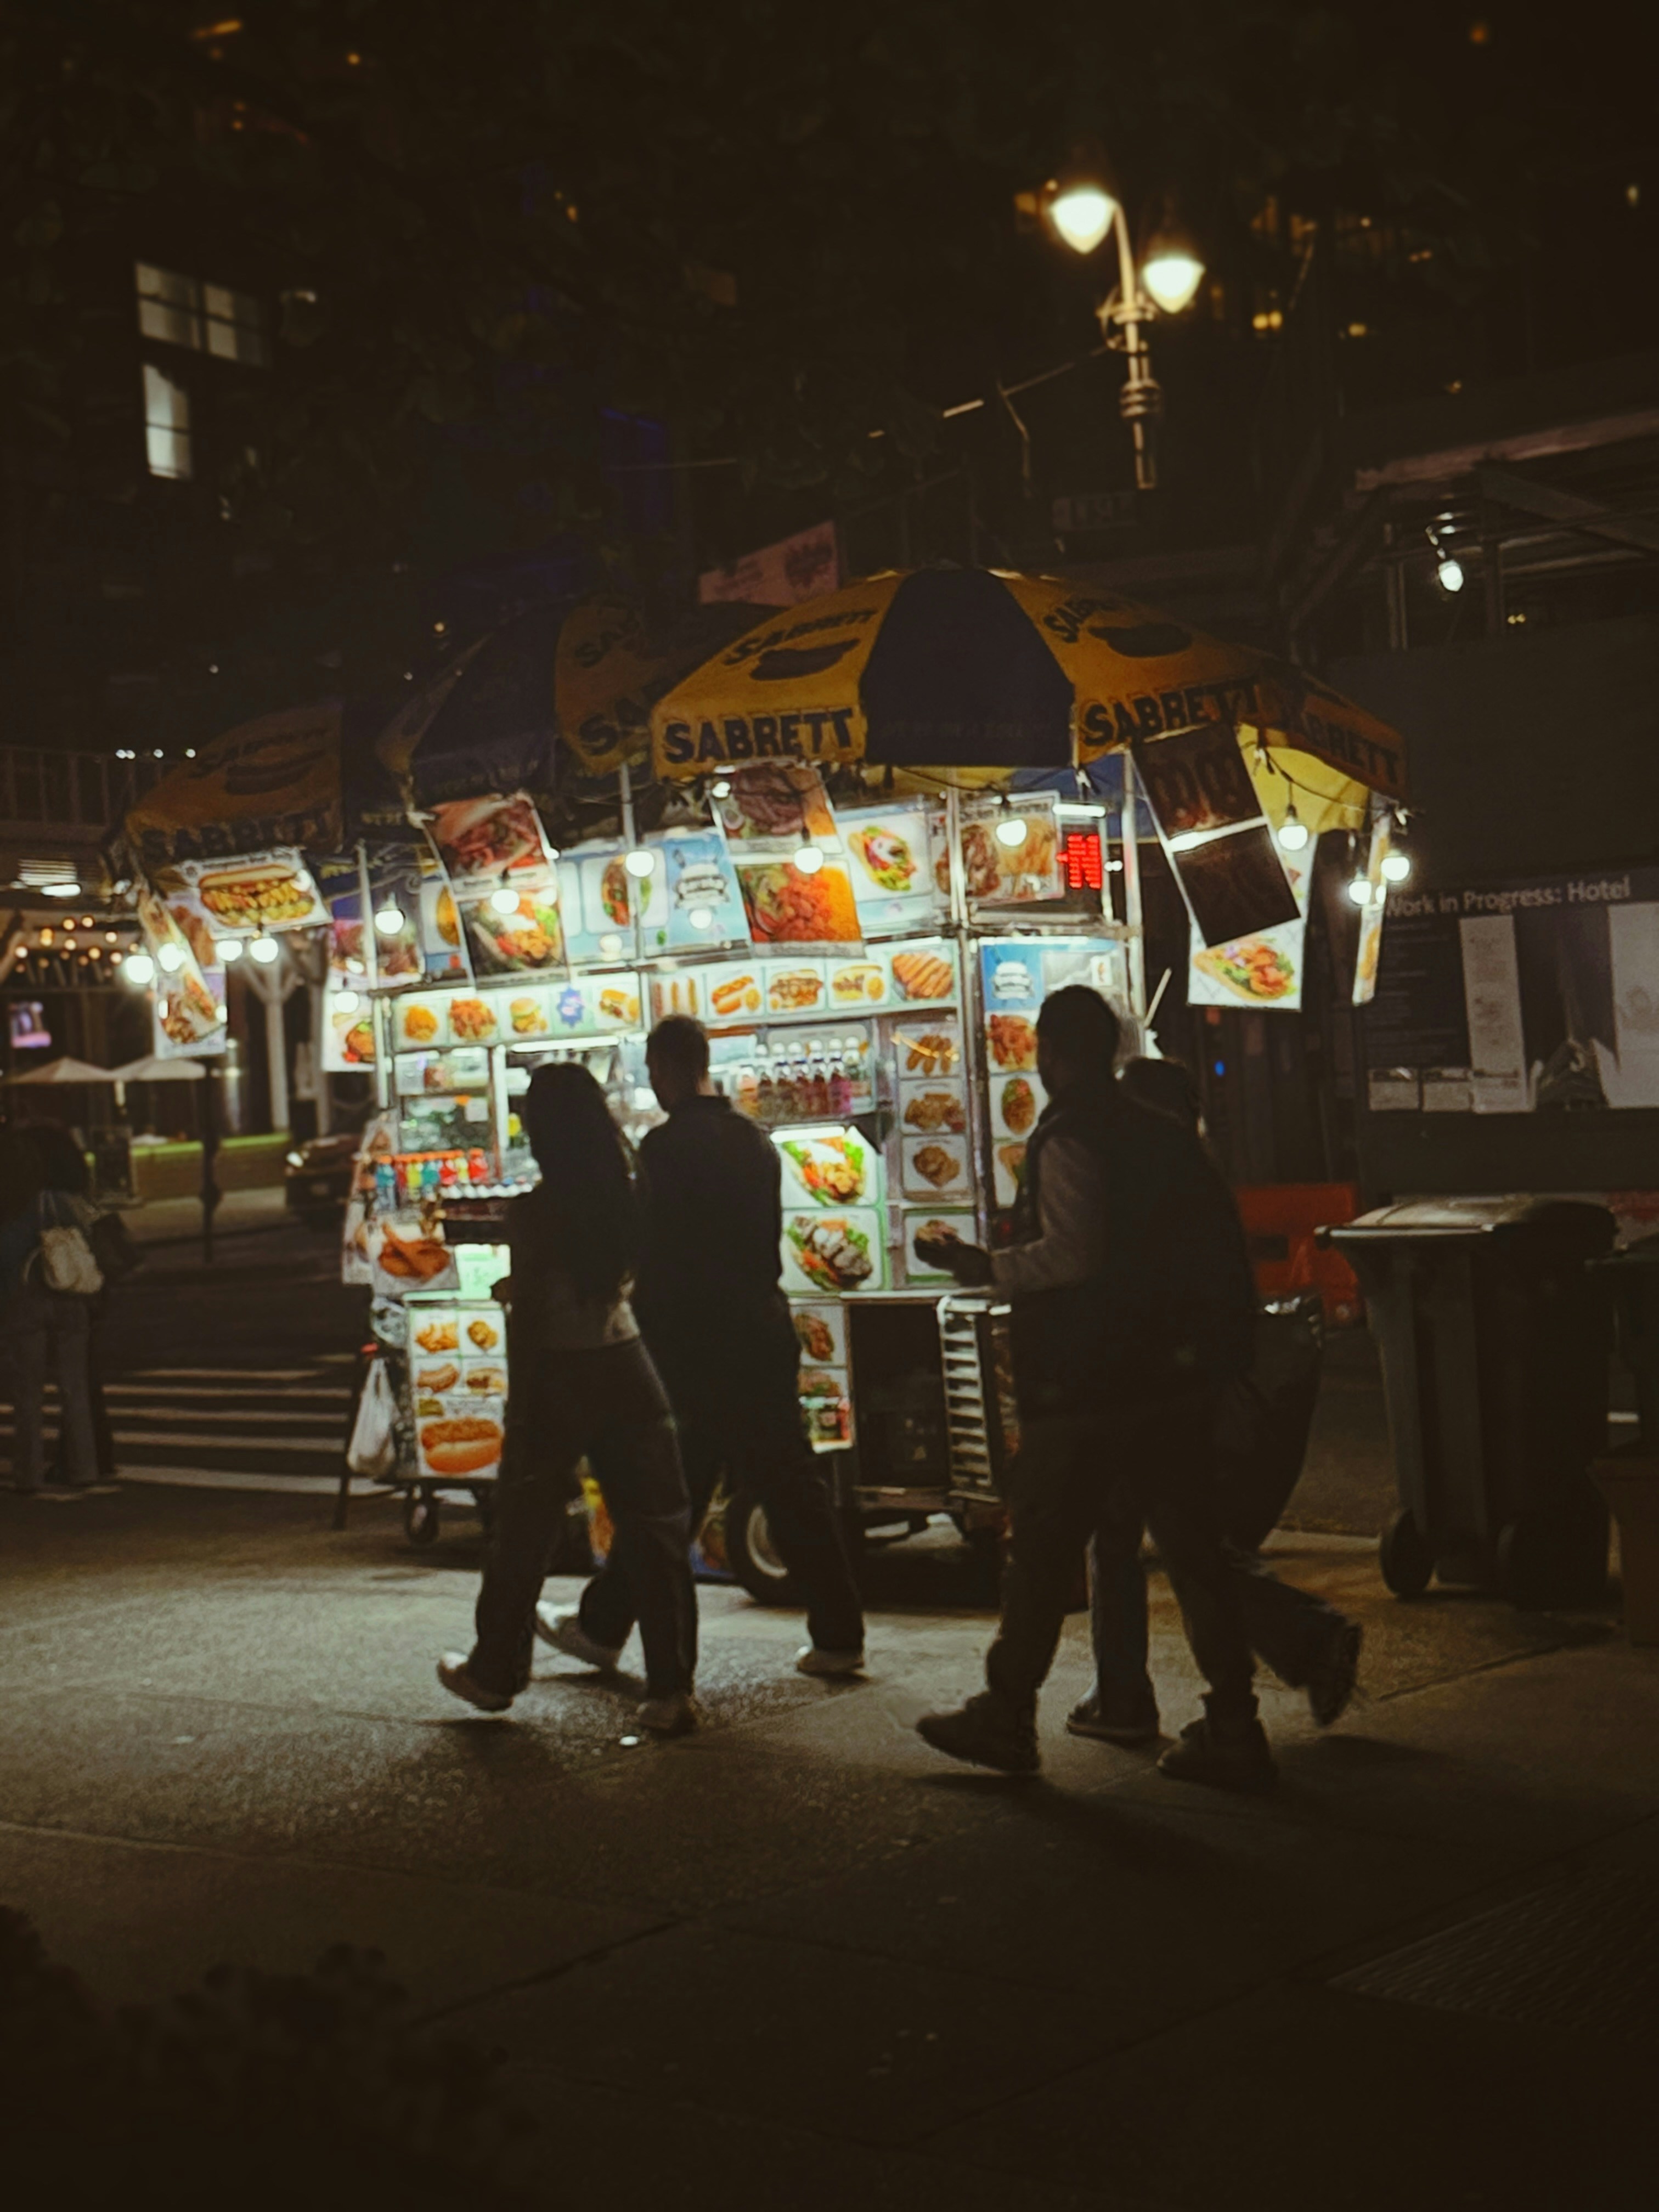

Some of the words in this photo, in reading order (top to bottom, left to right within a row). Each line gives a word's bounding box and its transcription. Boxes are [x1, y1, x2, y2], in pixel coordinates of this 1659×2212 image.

[665, 708, 855, 764] SABRETT
[1438, 891, 1458, 913] in
[1463, 887, 1562, 913] Progress:
[1567, 874, 1631, 904] Hotel
